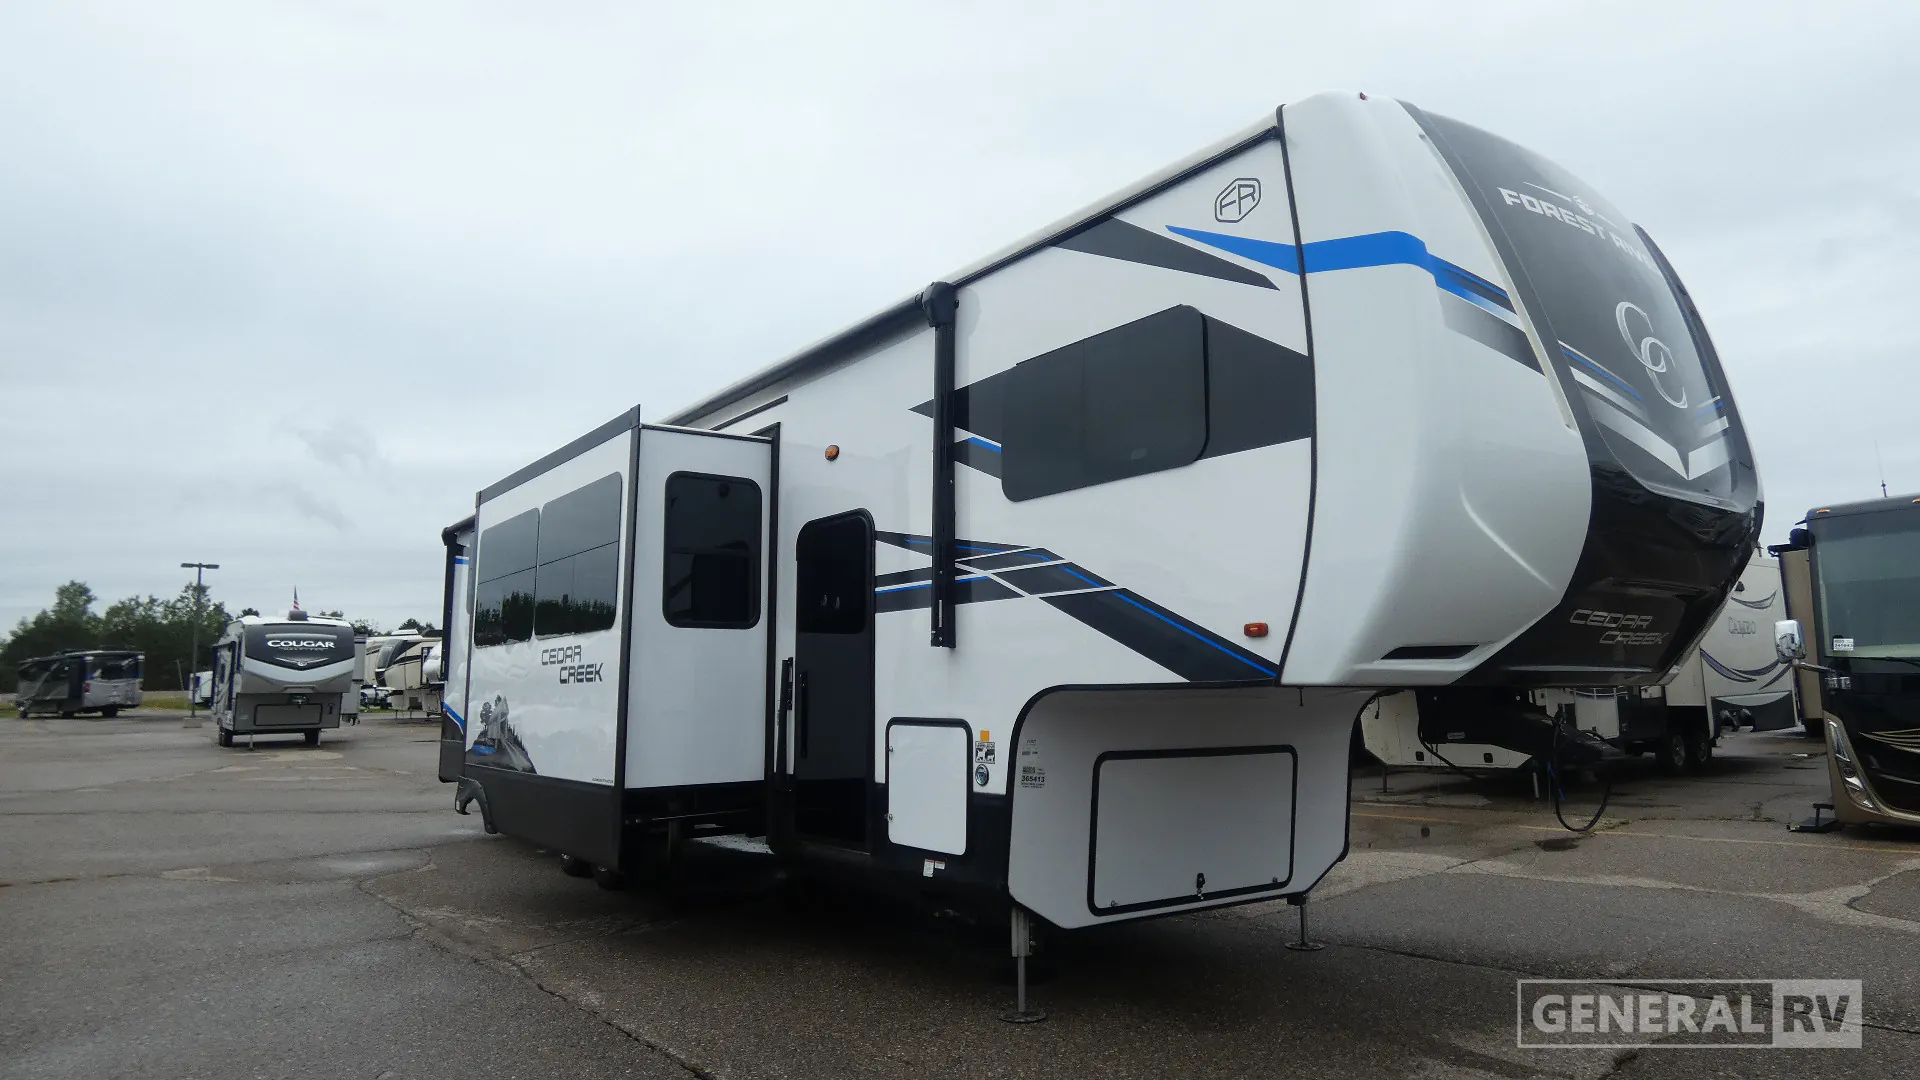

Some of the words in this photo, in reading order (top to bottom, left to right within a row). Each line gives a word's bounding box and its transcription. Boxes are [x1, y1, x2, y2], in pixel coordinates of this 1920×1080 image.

[1497, 187, 1605, 239] FOREST
[1570, 609, 1653, 629] CEDAR
[267, 640, 335, 649] COUGAR
[1599, 630, 1670, 645] CREEK
[541, 645, 581, 666] CEDAR
[560, 663, 604, 684] CREEK
[1021, 775, 1045, 783] 365413
